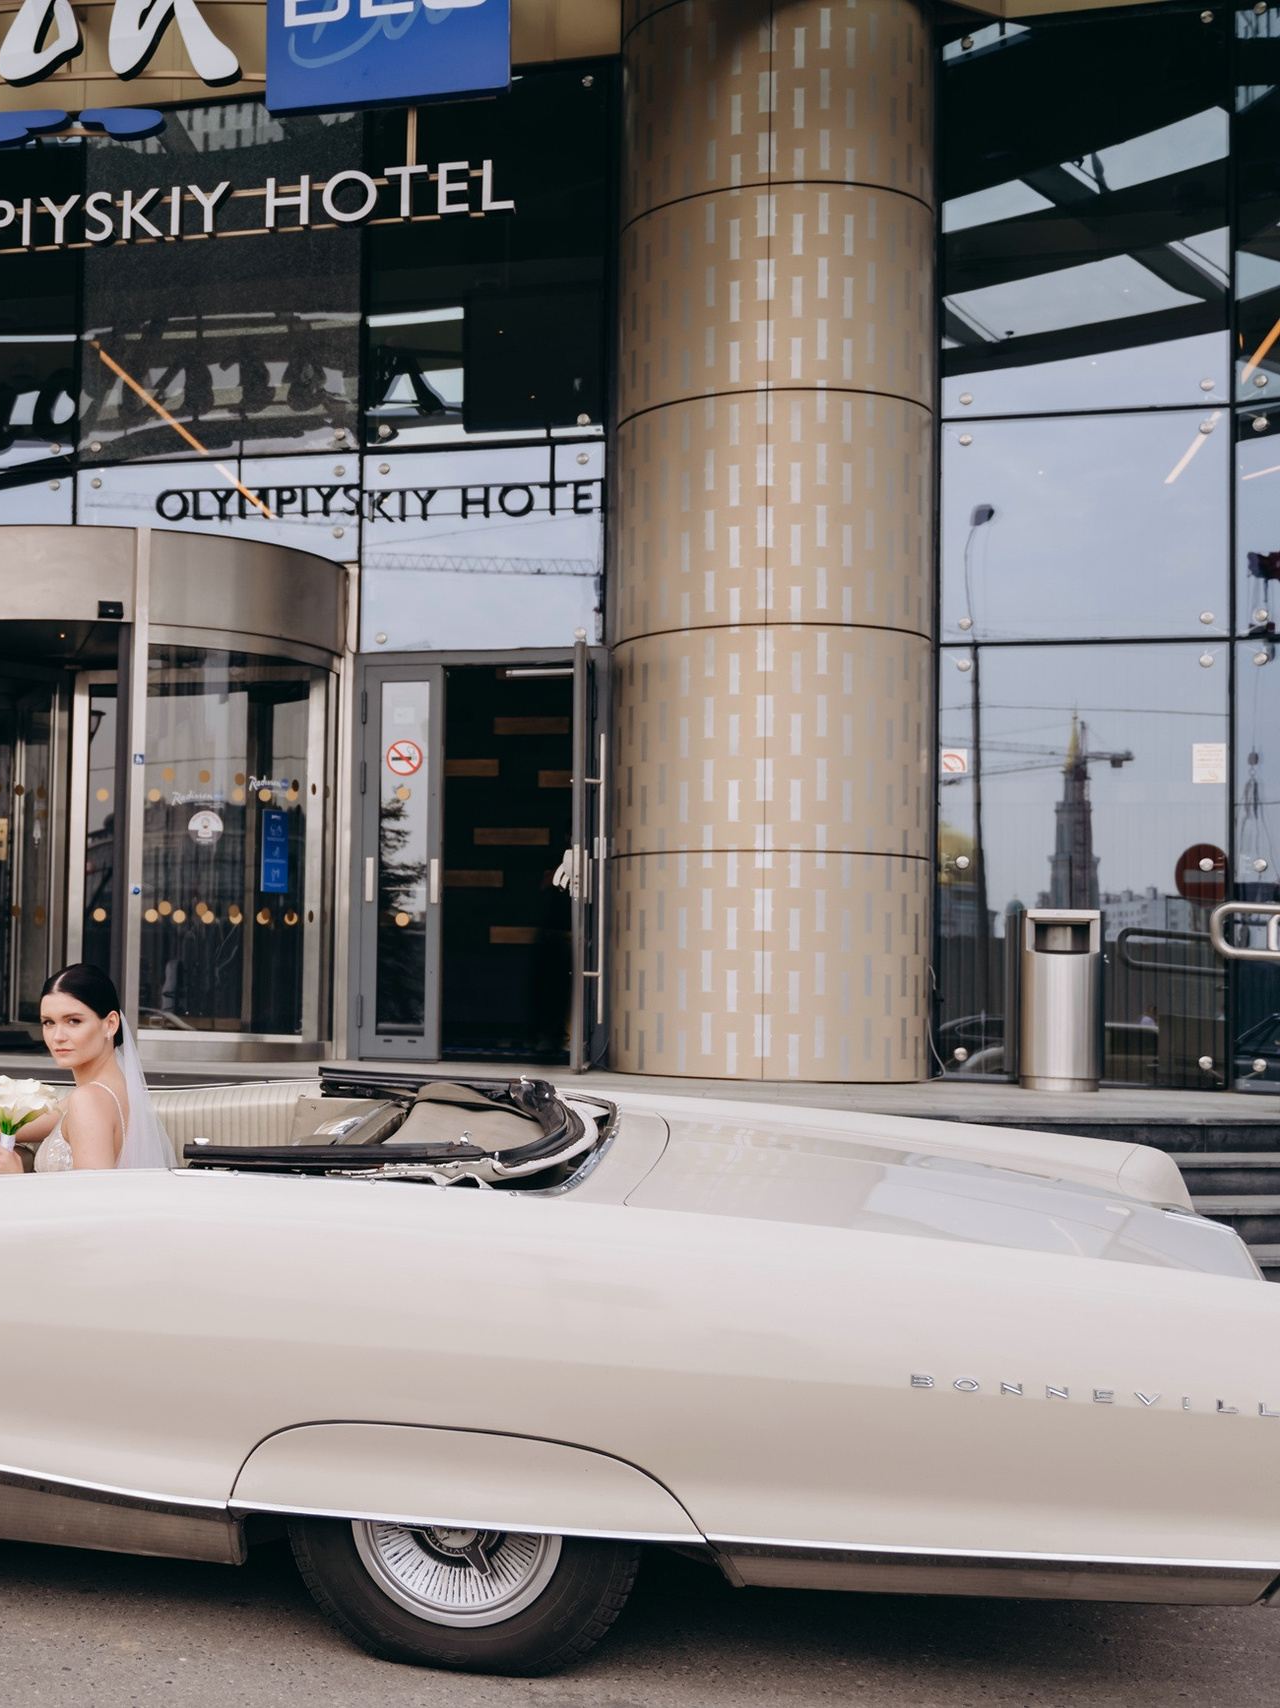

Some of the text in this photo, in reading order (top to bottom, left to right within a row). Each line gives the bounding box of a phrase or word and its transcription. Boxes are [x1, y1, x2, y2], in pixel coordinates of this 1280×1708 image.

[263, 158, 516, 229] HOTEL
[156, 480, 606, 522] OLYMPIYSKIY HOTE
[910, 1373, 1280, 1418] BONNEVILL
